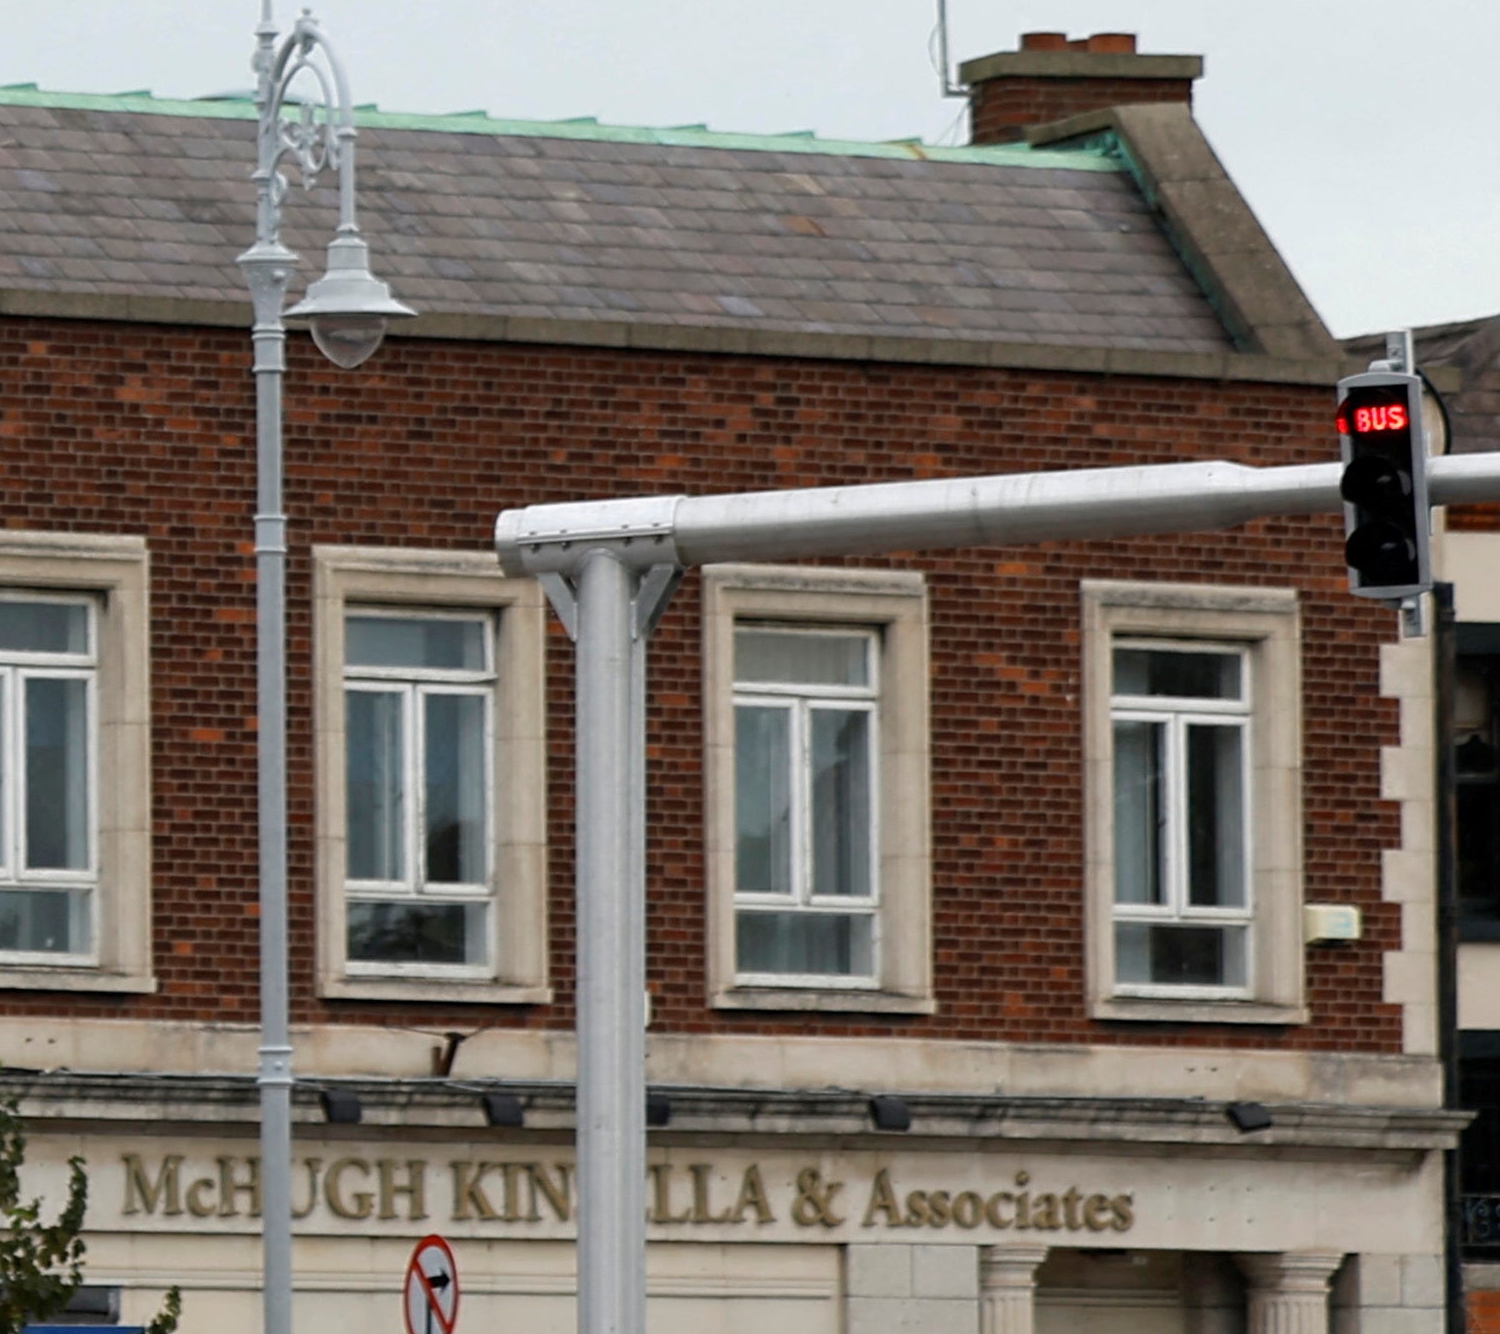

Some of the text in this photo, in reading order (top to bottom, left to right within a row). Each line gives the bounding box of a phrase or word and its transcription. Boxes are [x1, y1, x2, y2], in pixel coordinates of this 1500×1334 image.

[1356, 405, 1408, 433] BUS
[450, 1160, 776, 1226] KINLLA
[791, 1168, 845, 1228] &
[861, 1168, 1136, 1232] Associates
